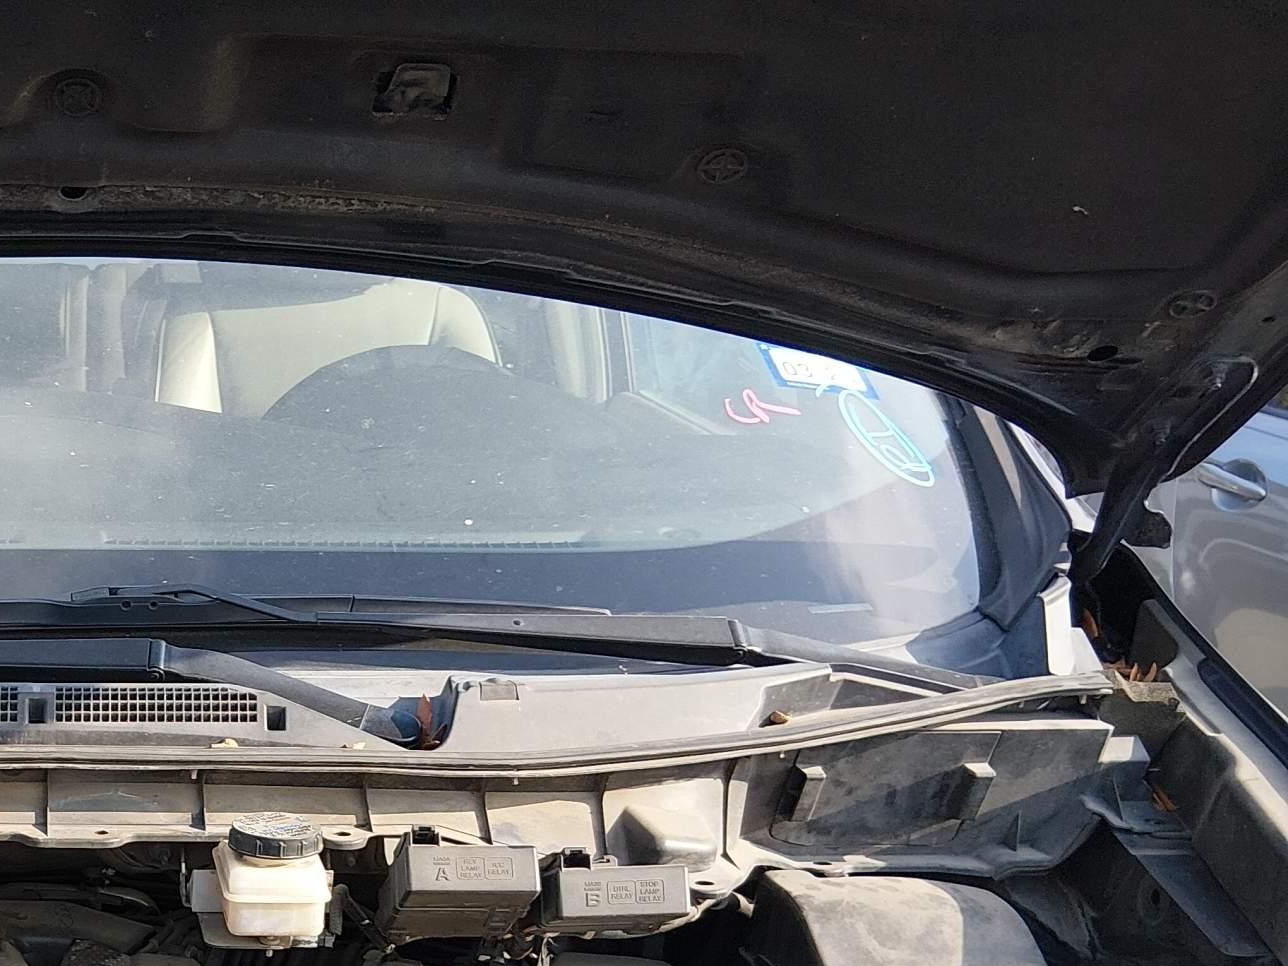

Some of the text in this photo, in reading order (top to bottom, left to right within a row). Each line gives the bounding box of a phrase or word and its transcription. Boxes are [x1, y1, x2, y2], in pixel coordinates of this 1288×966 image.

[435, 867, 452, 881] A
[585, 892, 601, 907] B
[610, 892, 633, 900] RELAY
